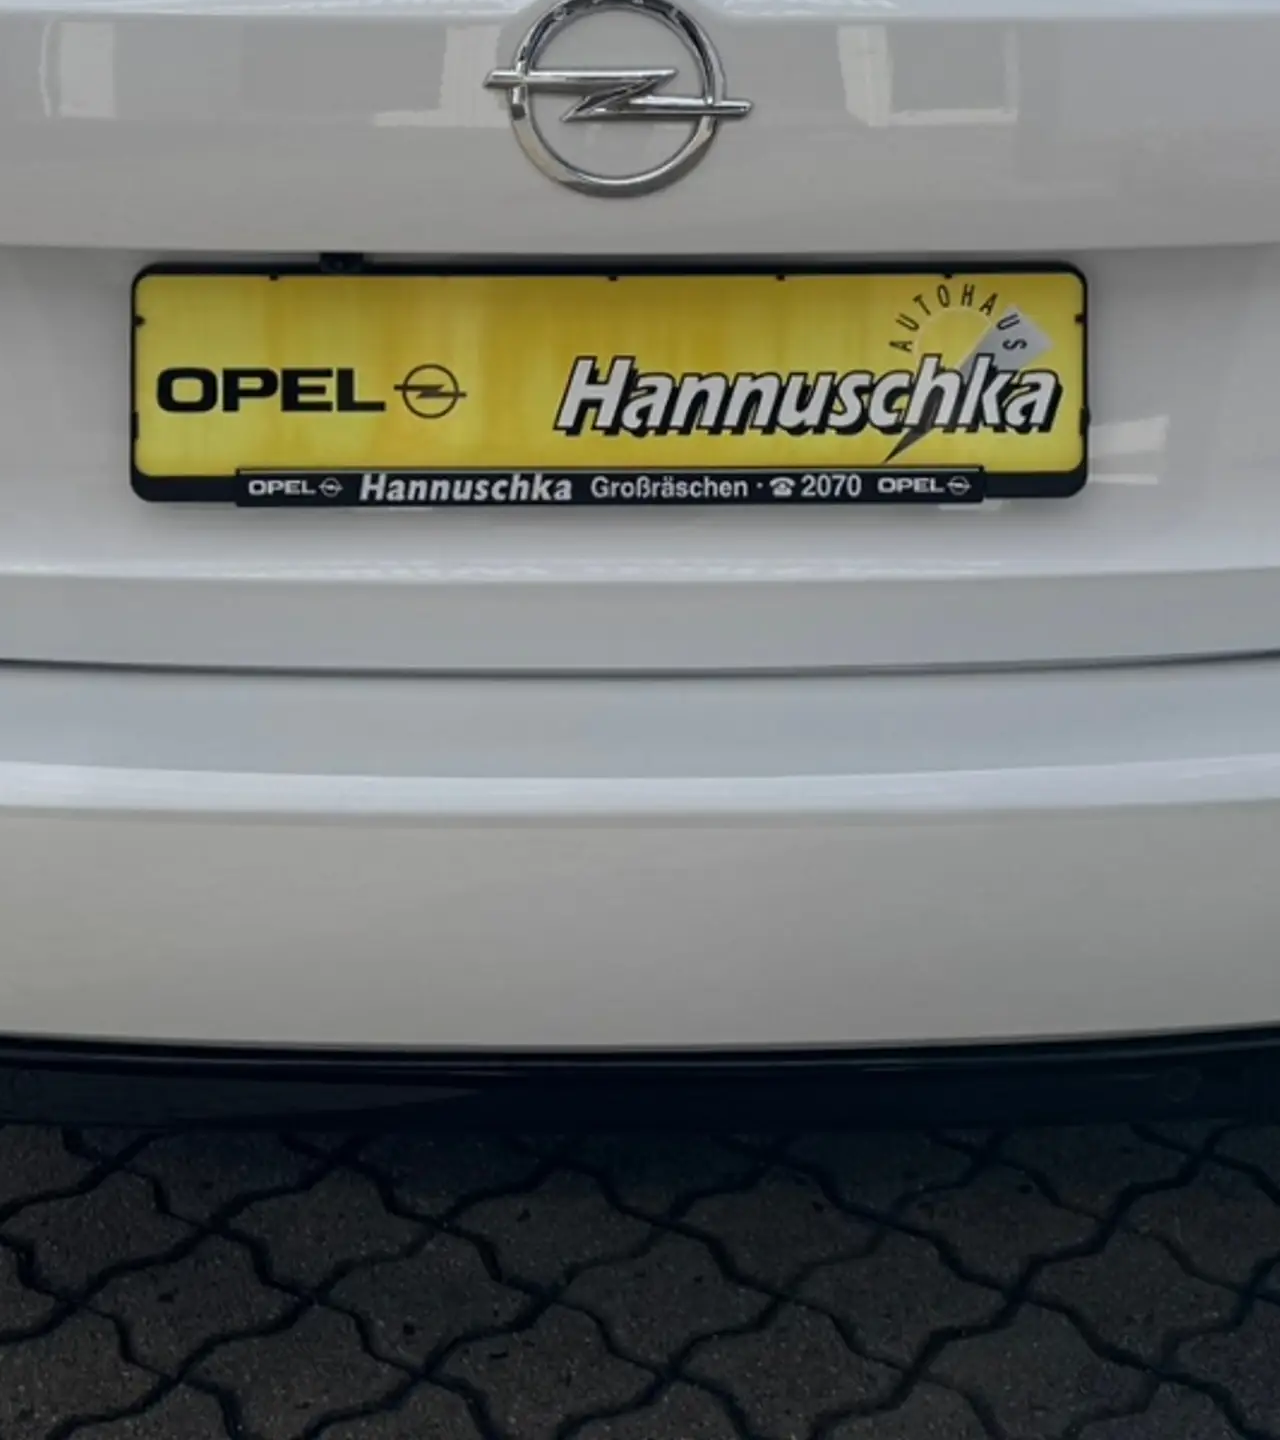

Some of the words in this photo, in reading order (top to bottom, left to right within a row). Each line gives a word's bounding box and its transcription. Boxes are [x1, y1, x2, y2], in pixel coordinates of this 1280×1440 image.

[889, 283, 1027, 353] AUTOHAUS
[156, 367, 387, 413] OPEL
[553, 354, 1063, 436] Hannuschka
[247, 479, 316, 497] OPEL
[359, 473, 573, 501] Hannuschka
[590, 475, 748, 499] Großräschen
[801, 475, 862, 497] 2070
[877, 477, 945, 494] OPEL
